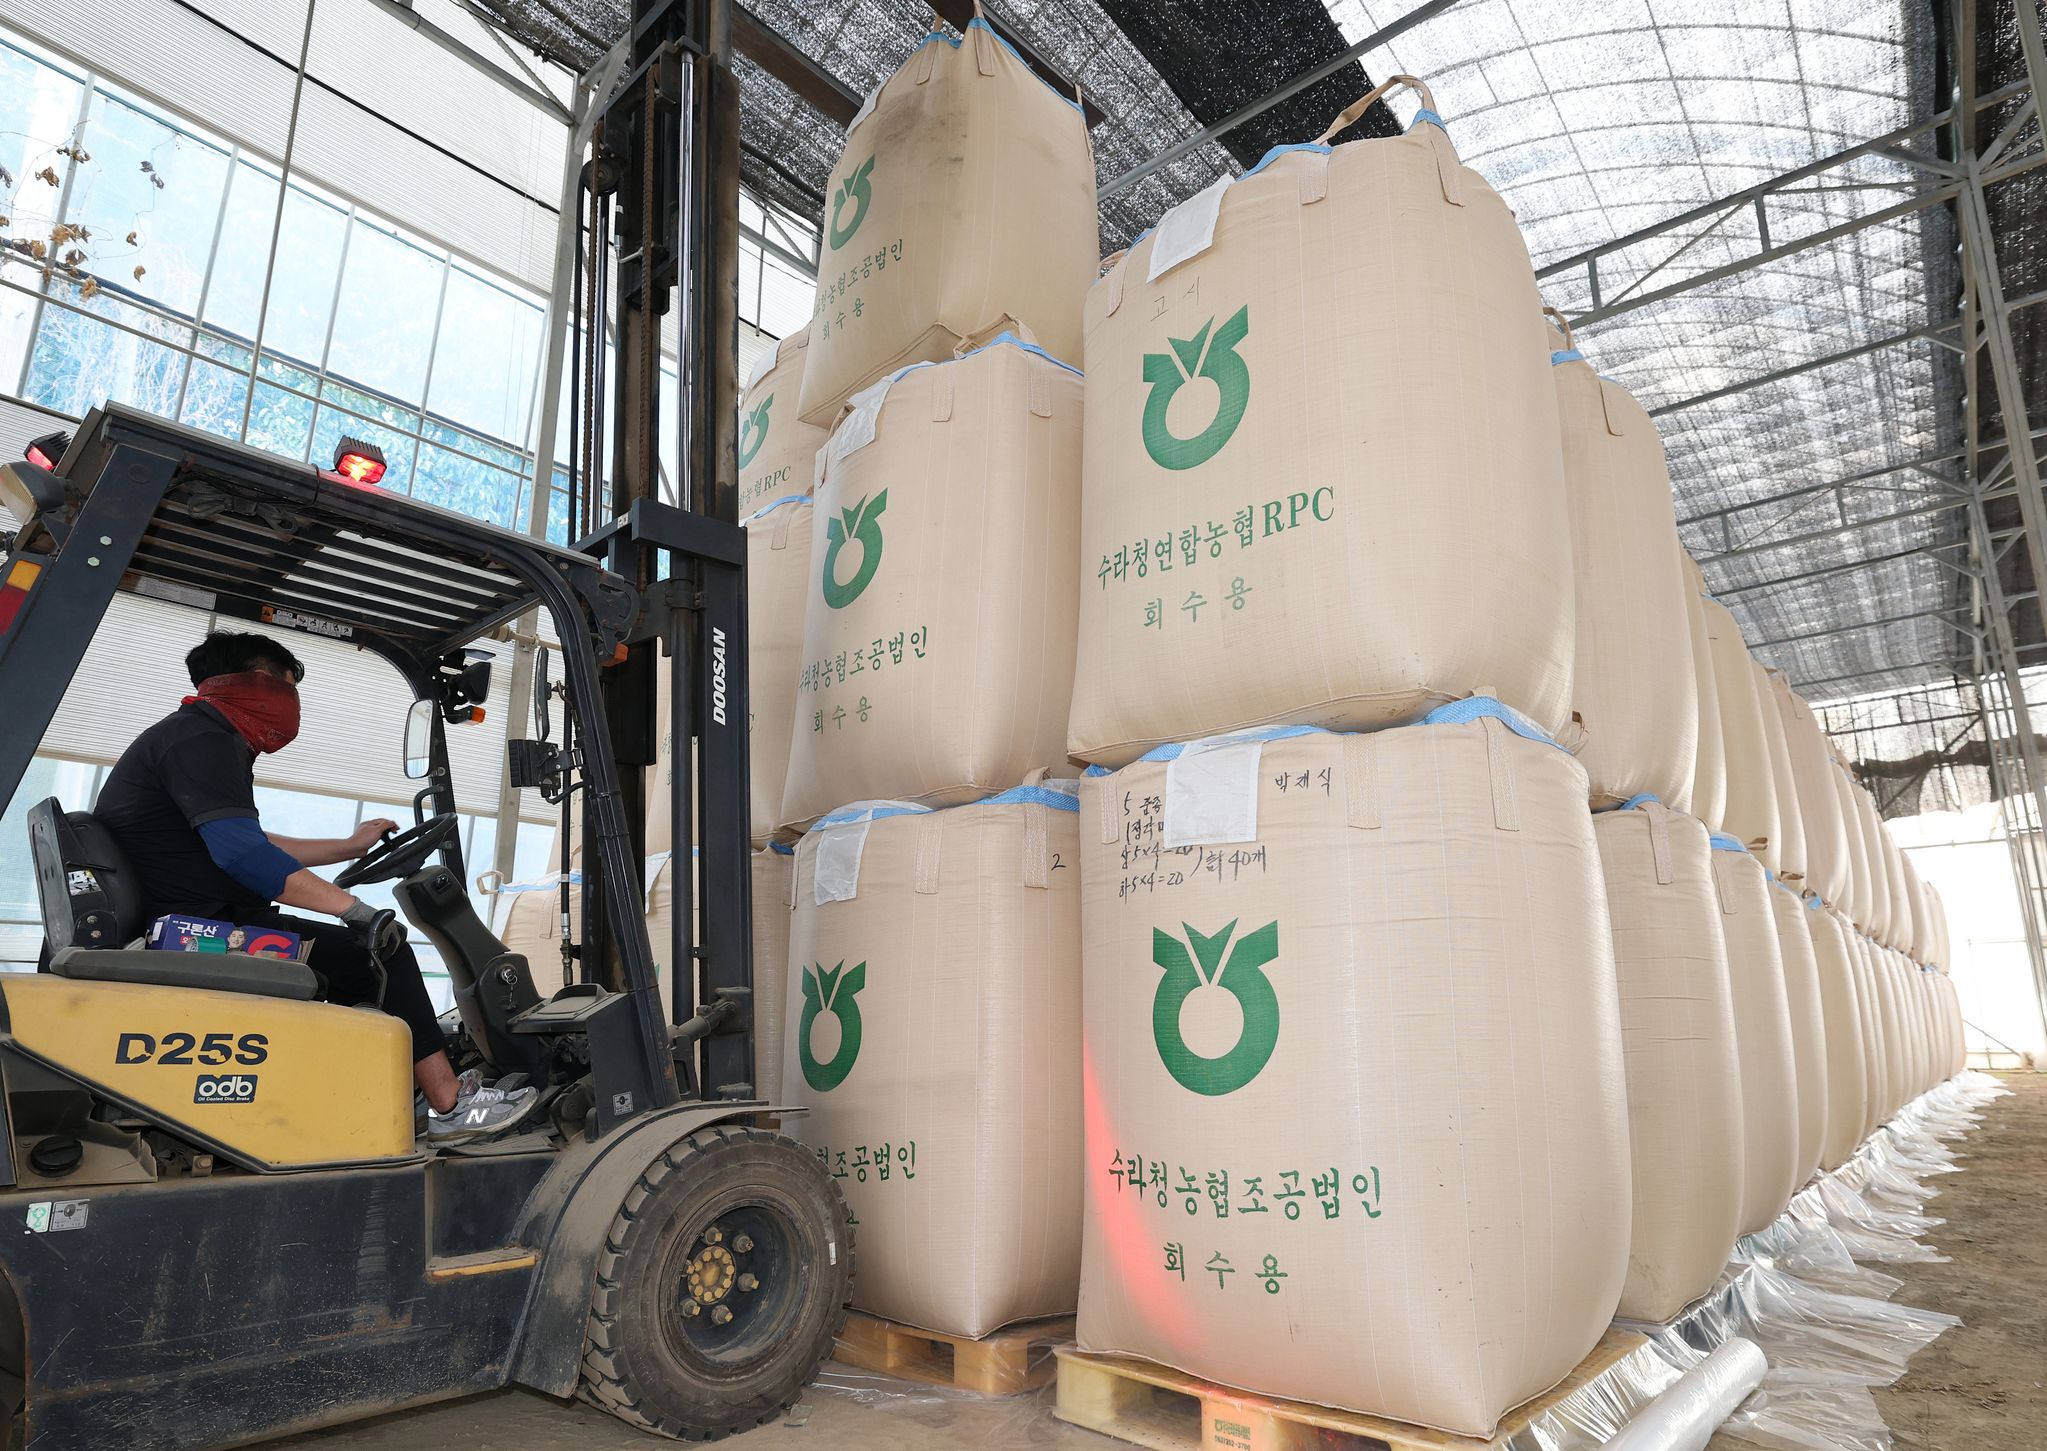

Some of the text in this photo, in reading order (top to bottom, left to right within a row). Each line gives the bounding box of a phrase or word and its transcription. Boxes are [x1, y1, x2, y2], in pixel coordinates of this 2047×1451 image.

[1098, 486, 1335, 590] 수라청연합농협RPC
[712, 626, 726, 726] DOOSAN
[1051, 853, 1067, 871] 2
[177, 921, 217, 938] 구론산
[115, 1032, 269, 1066] D25S
[198, 1076, 253, 1097] odb
[464, 1108, 489, 1124] N
[1108, 1148, 1382, 1220] 수라청농협조공법인
